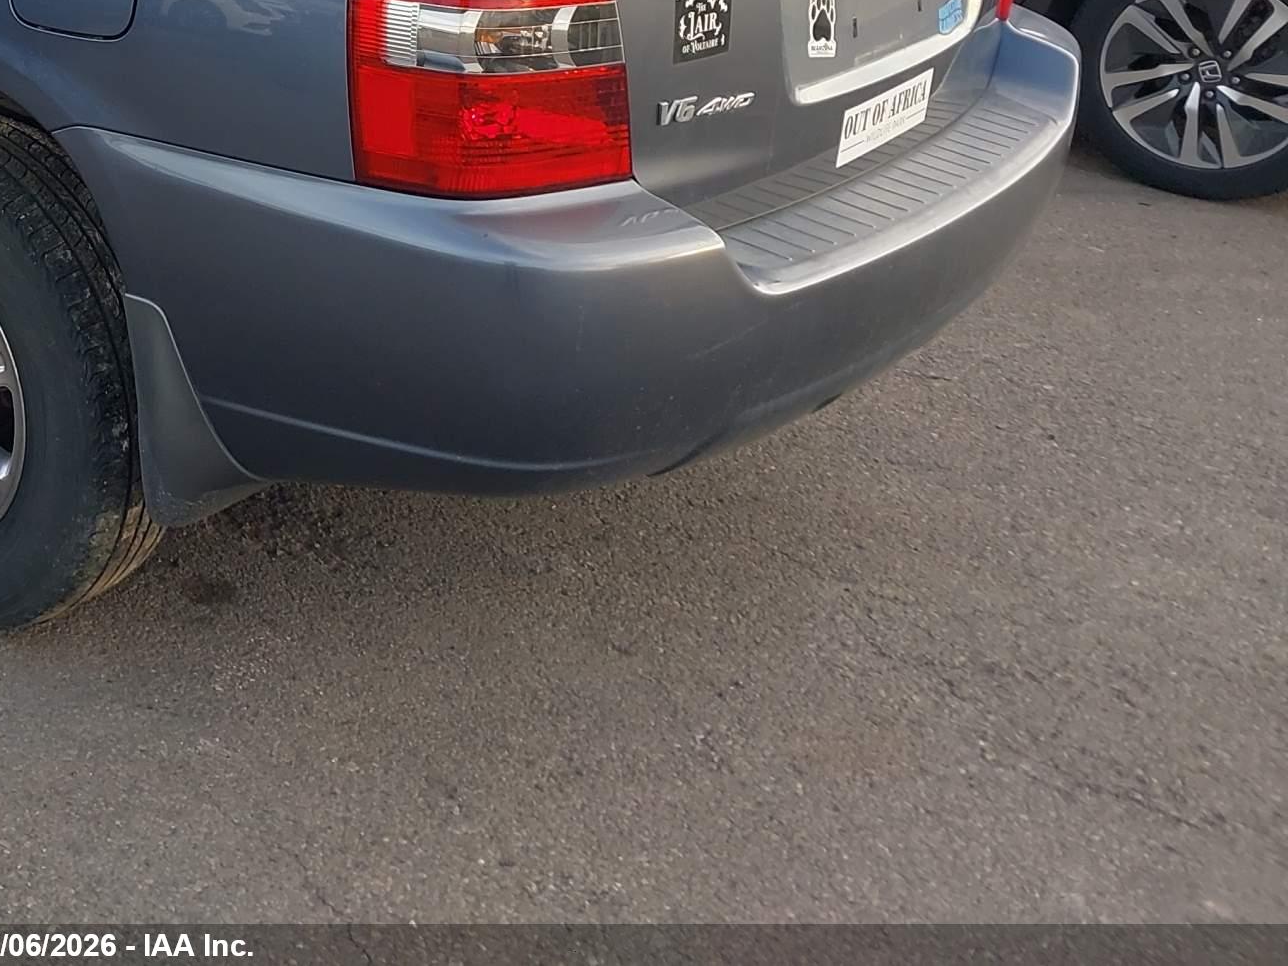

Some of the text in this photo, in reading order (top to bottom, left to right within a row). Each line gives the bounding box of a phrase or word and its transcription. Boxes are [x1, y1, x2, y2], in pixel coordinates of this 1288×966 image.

[686, 10, 722, 41] LAIR
[656, 92, 755, 126] V6 4WD
[843, 107, 872, 141] OUT
[872, 98, 890, 127] OF
[888, 80, 928, 120] AFRICA
